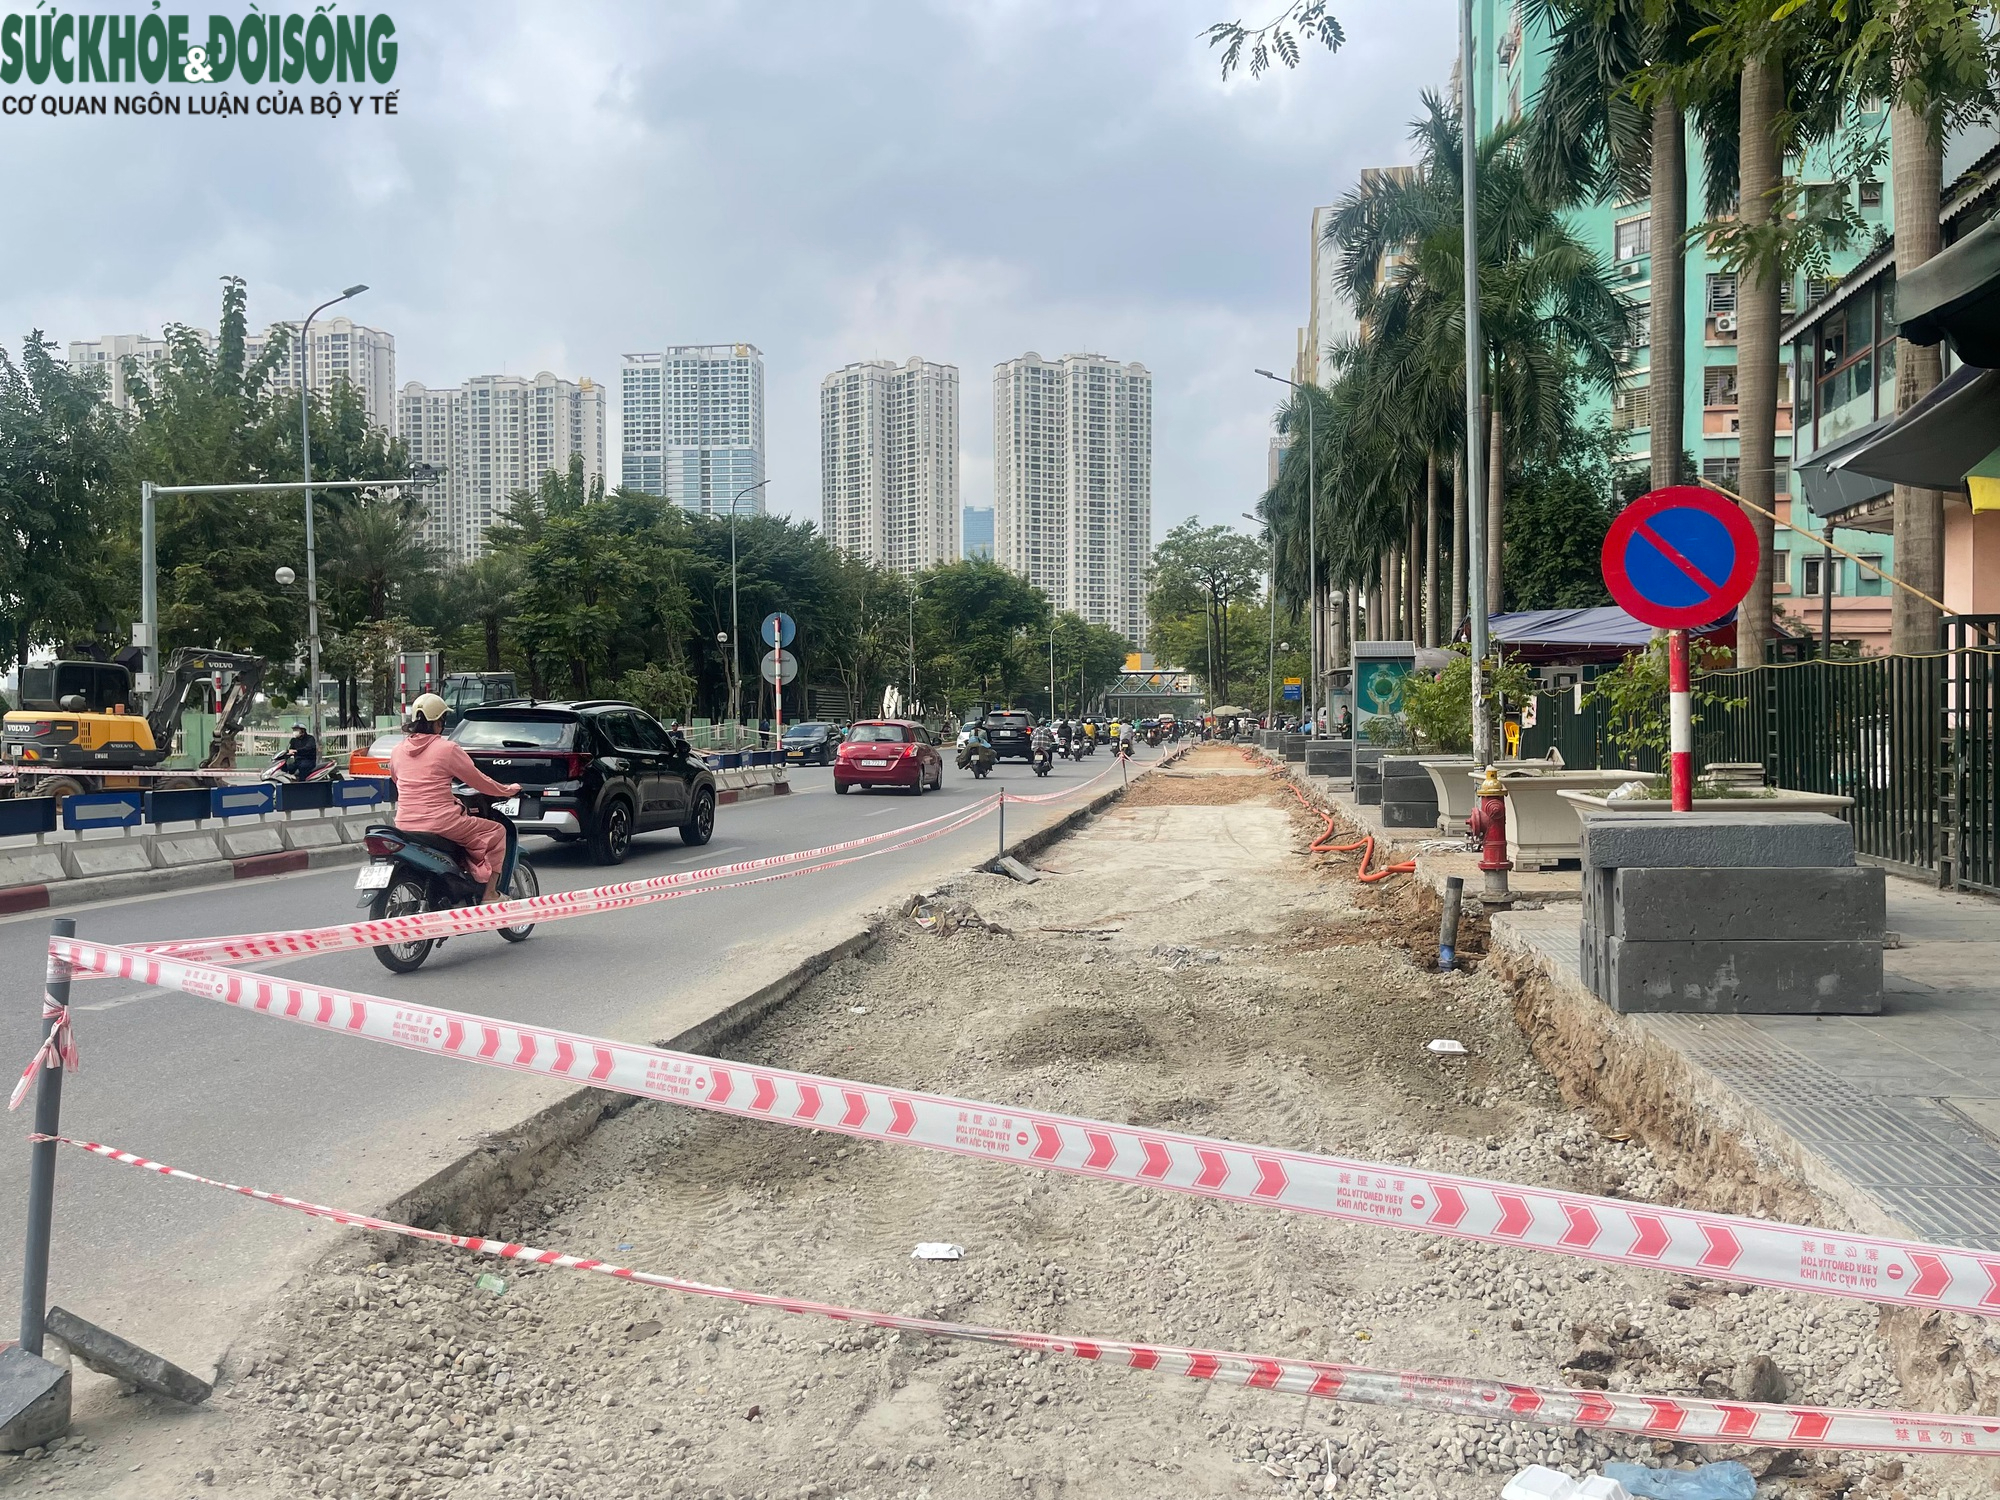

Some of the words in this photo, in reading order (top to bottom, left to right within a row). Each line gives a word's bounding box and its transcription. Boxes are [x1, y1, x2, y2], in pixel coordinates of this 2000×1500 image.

[208, 661, 234, 669] VOLVO
[7, 724, 30, 732] VOLVO
[1894, 1427, 1977, 1446] 禁區勿進
